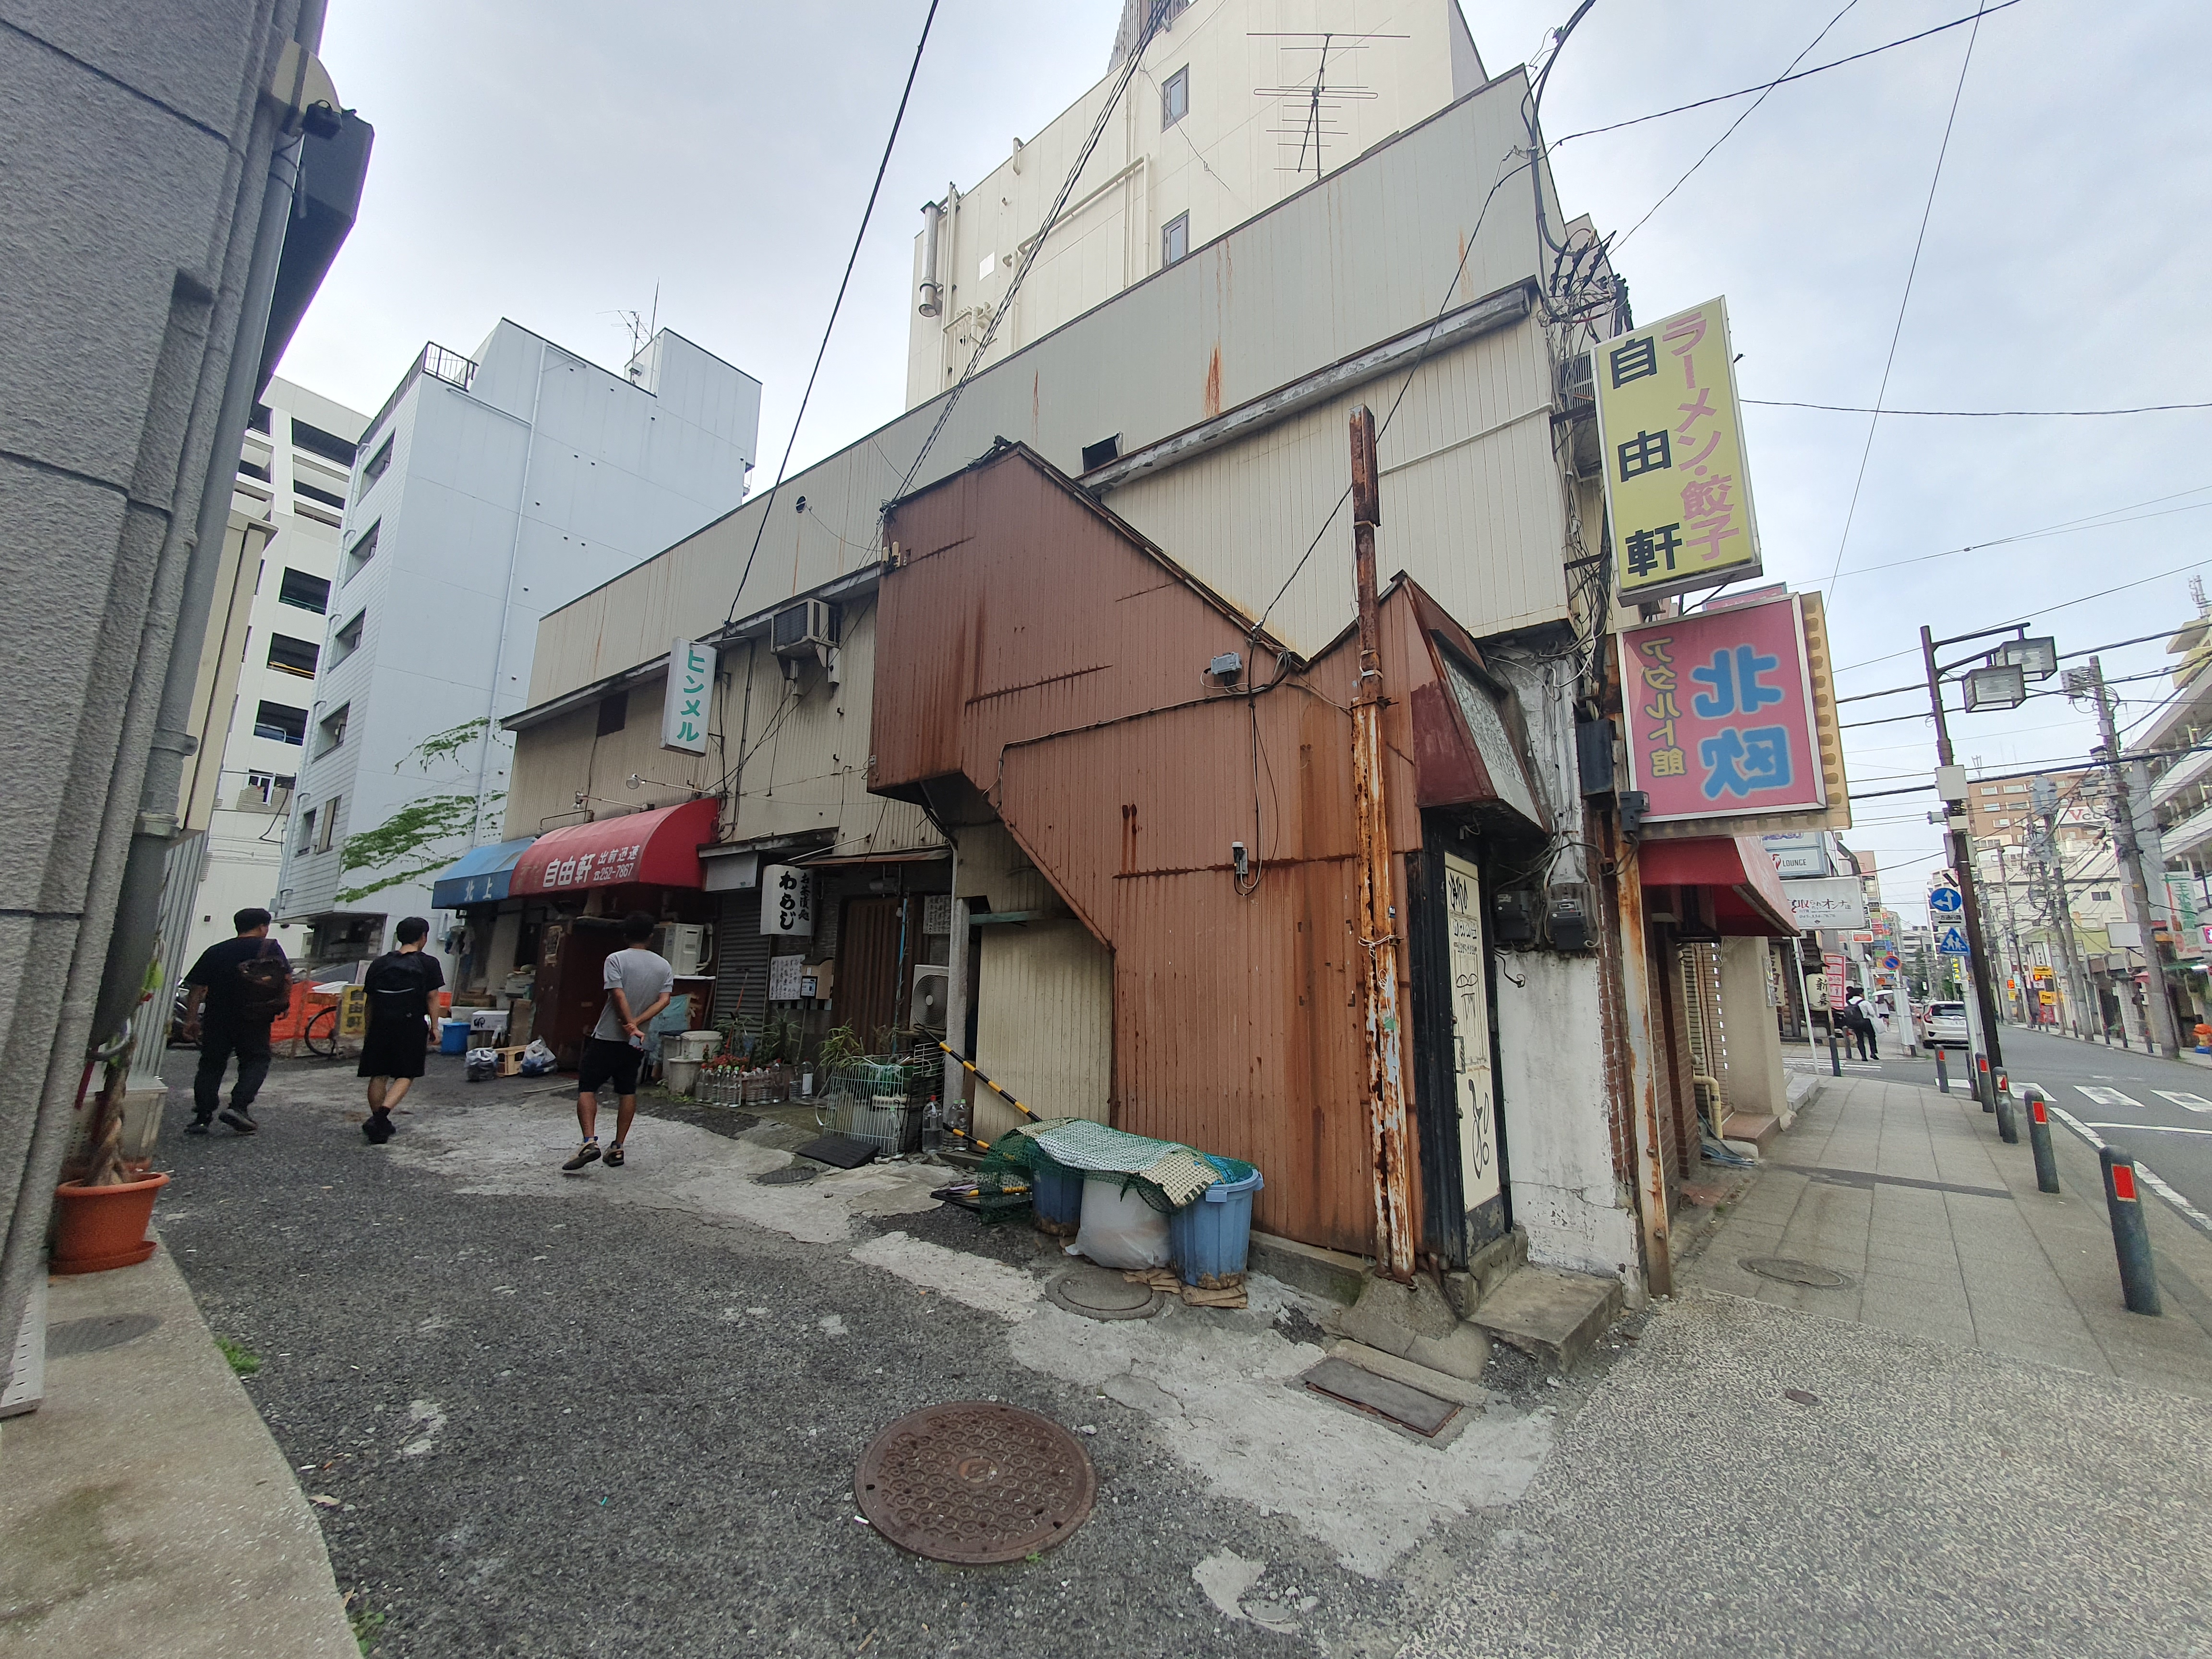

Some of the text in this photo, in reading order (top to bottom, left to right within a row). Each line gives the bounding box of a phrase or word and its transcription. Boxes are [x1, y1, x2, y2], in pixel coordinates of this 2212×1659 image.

[1662, 312, 1739, 562] ラーメン・餃子
[1609, 336, 1683, 576] 自由軒
[676, 649, 707, 743] ヒンメル
[542, 853, 596, 888] 自由軒
[597, 844, 640, 866] 出前迅速
[600, 863, 634, 880] 252-7867
[1782, 859, 1807, 867] LOUNGE
[464, 878, 493, 902] 北上
[779, 870, 797, 930] わらじ
[347, 989, 364, 1028] 自由軒
